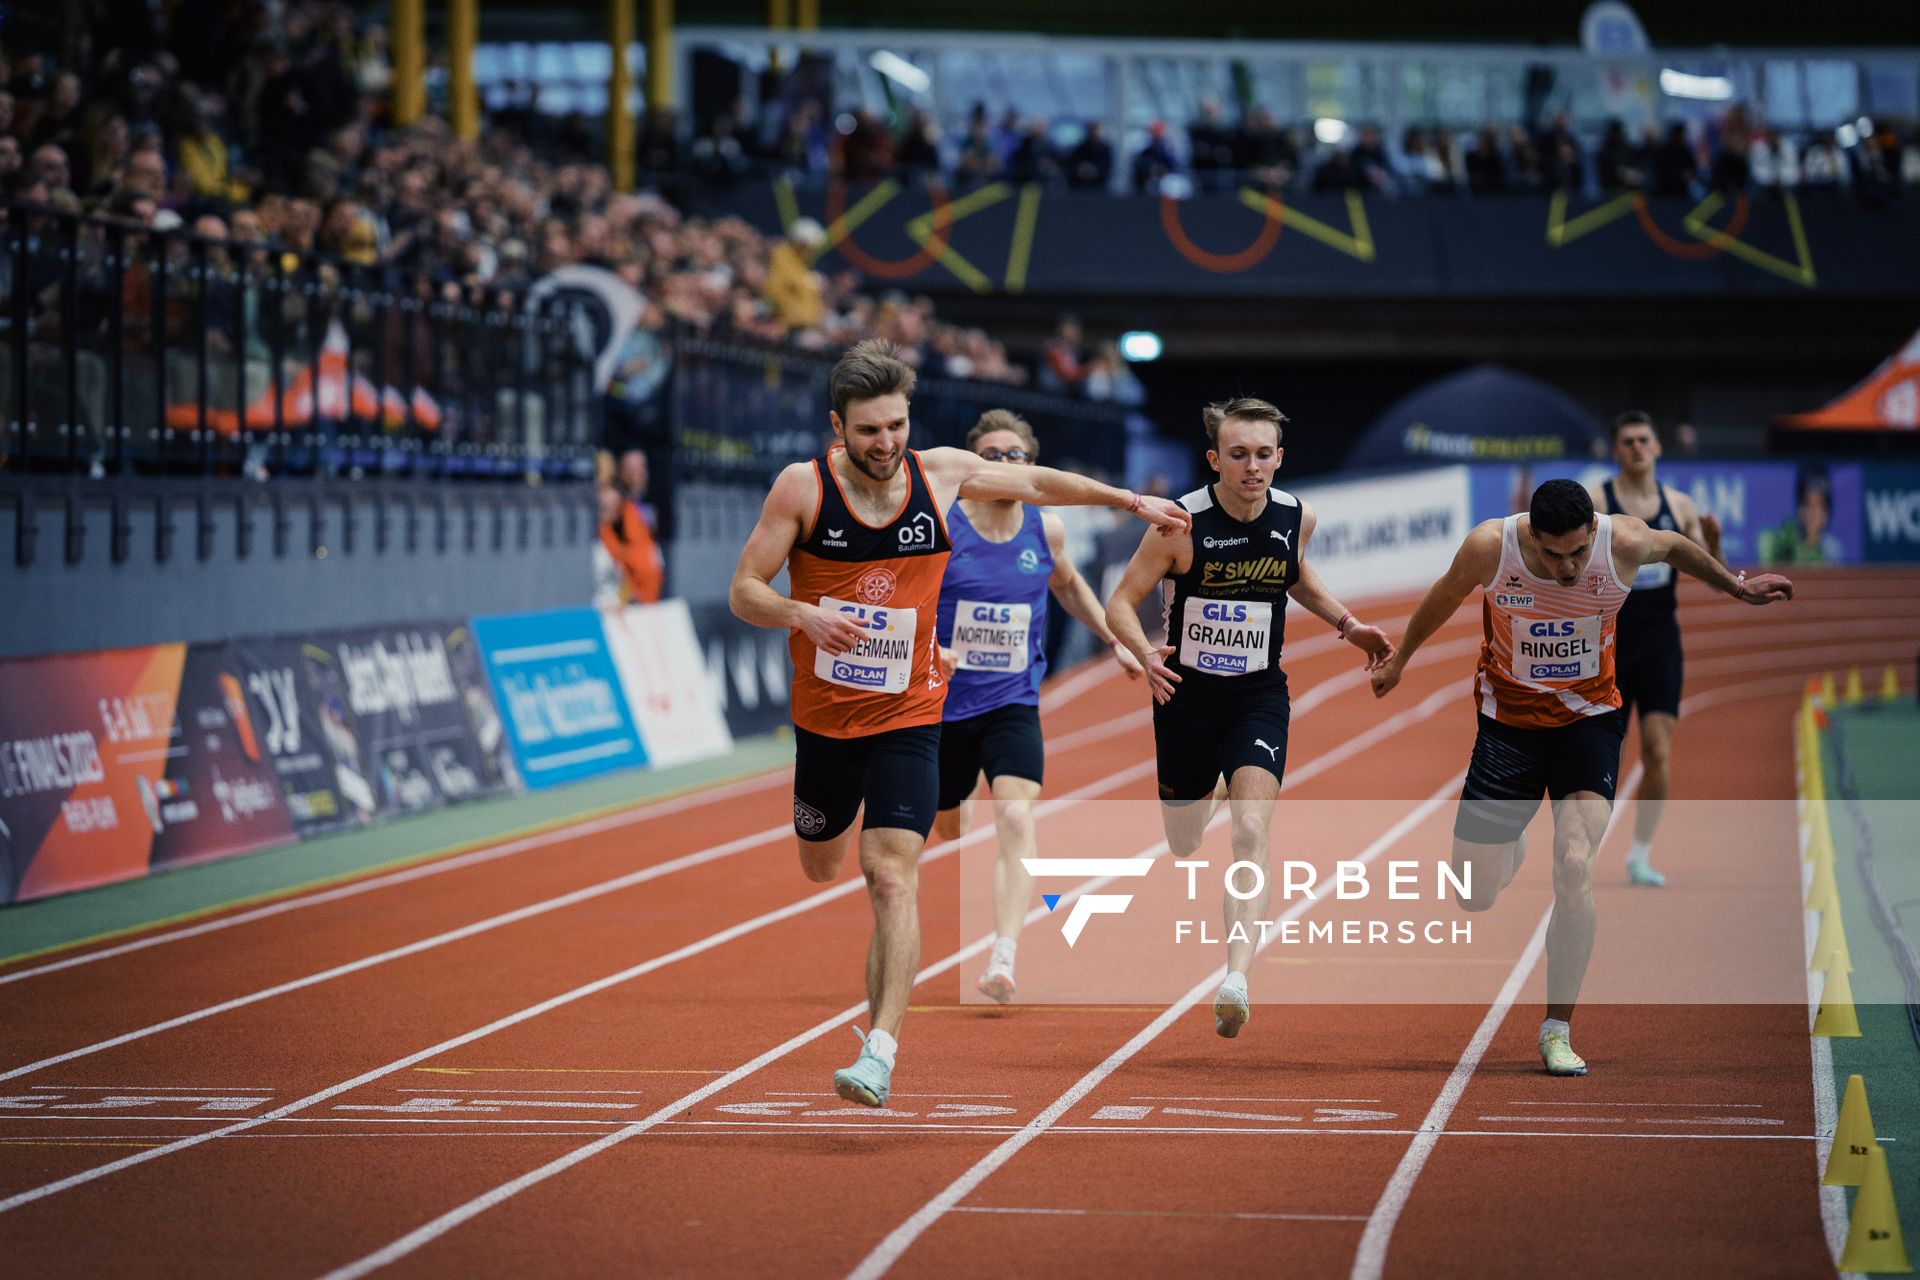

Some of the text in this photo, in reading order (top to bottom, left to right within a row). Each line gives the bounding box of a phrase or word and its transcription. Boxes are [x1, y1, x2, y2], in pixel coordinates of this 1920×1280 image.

[898, 525, 926, 544] OS
[822, 539, 848, 547] erima
[1510, 595, 1533, 605] EWP
[956, 625, 1026, 647] NORTMEYER
[1187, 623, 1265, 649] GRAIANI
[1521, 638, 1592, 658] RINGEL
[1217, 656, 1245, 668] PLAN
[853, 668, 885, 680] PLAN
[1551, 664, 1579, 673] PLAN
